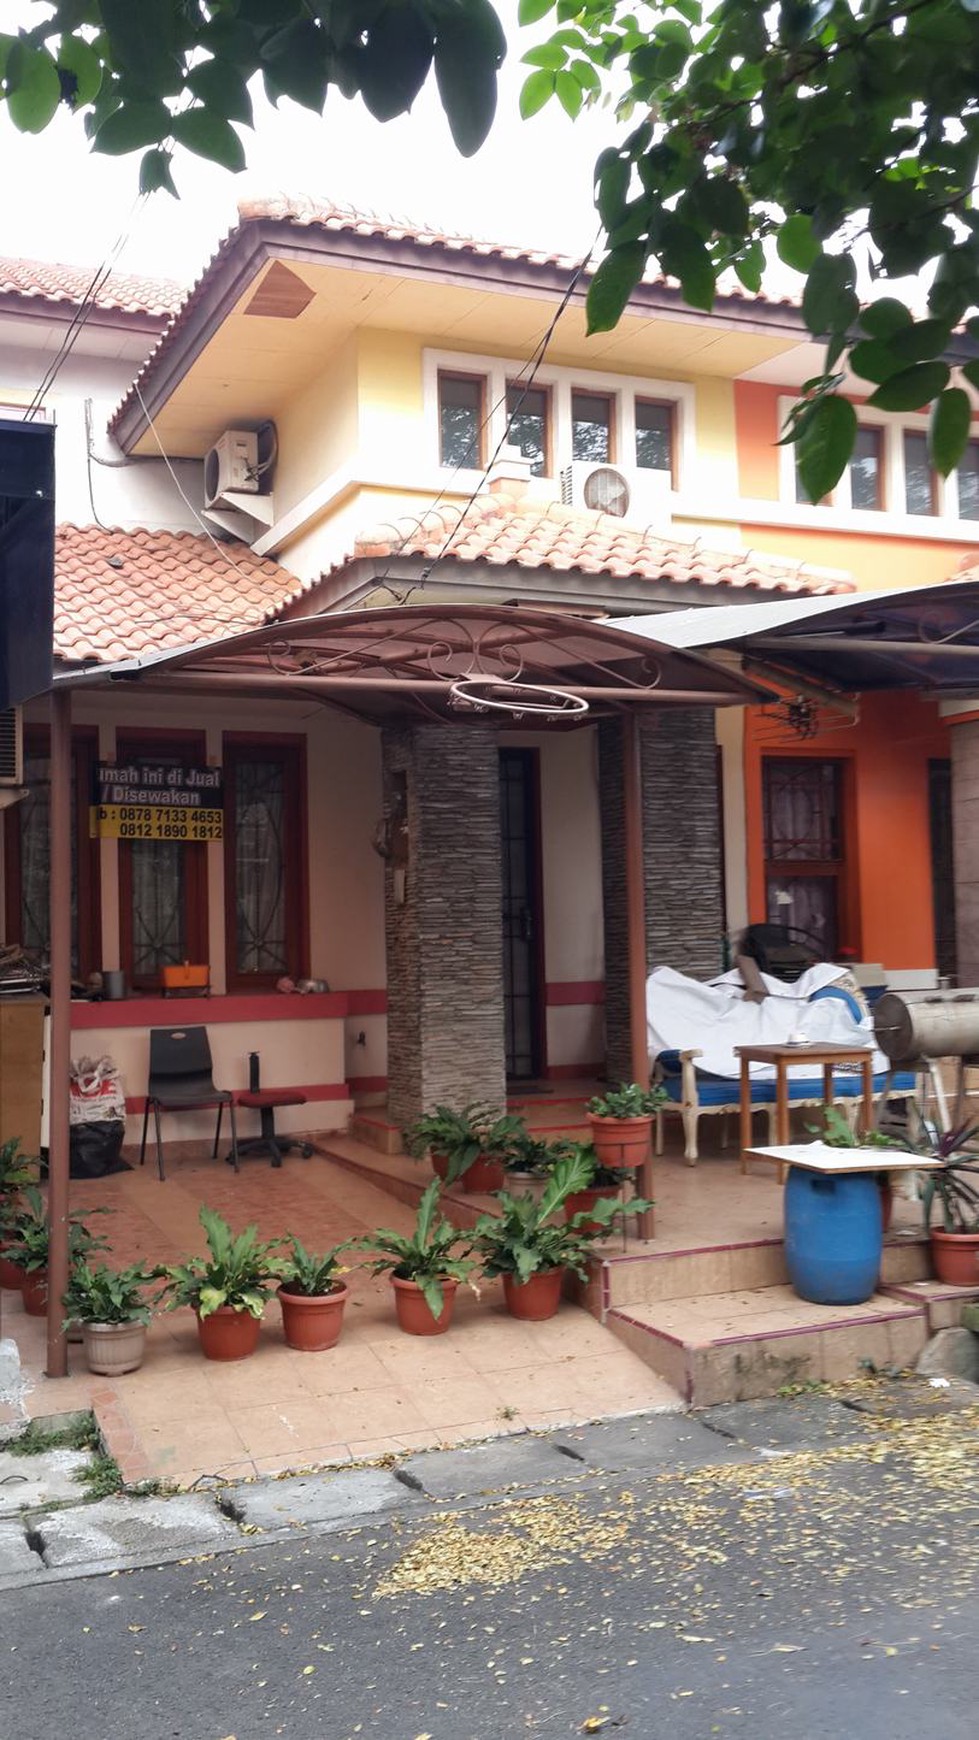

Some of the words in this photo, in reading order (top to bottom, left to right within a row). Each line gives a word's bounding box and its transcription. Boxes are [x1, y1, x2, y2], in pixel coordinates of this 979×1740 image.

[144, 767, 163, 783] ini
[167, 769, 182, 785] di
[186, 770, 220, 787] Jual
[113, 786, 201, 805] Disewakan
[119, 808, 151, 821] 0878
[156, 810, 188, 823] 7133
[191, 811, 222, 824] 4653
[119, 823, 152, 836] 0812
[157, 825, 188, 838] 1890
[192, 826, 222, 839] 1812
